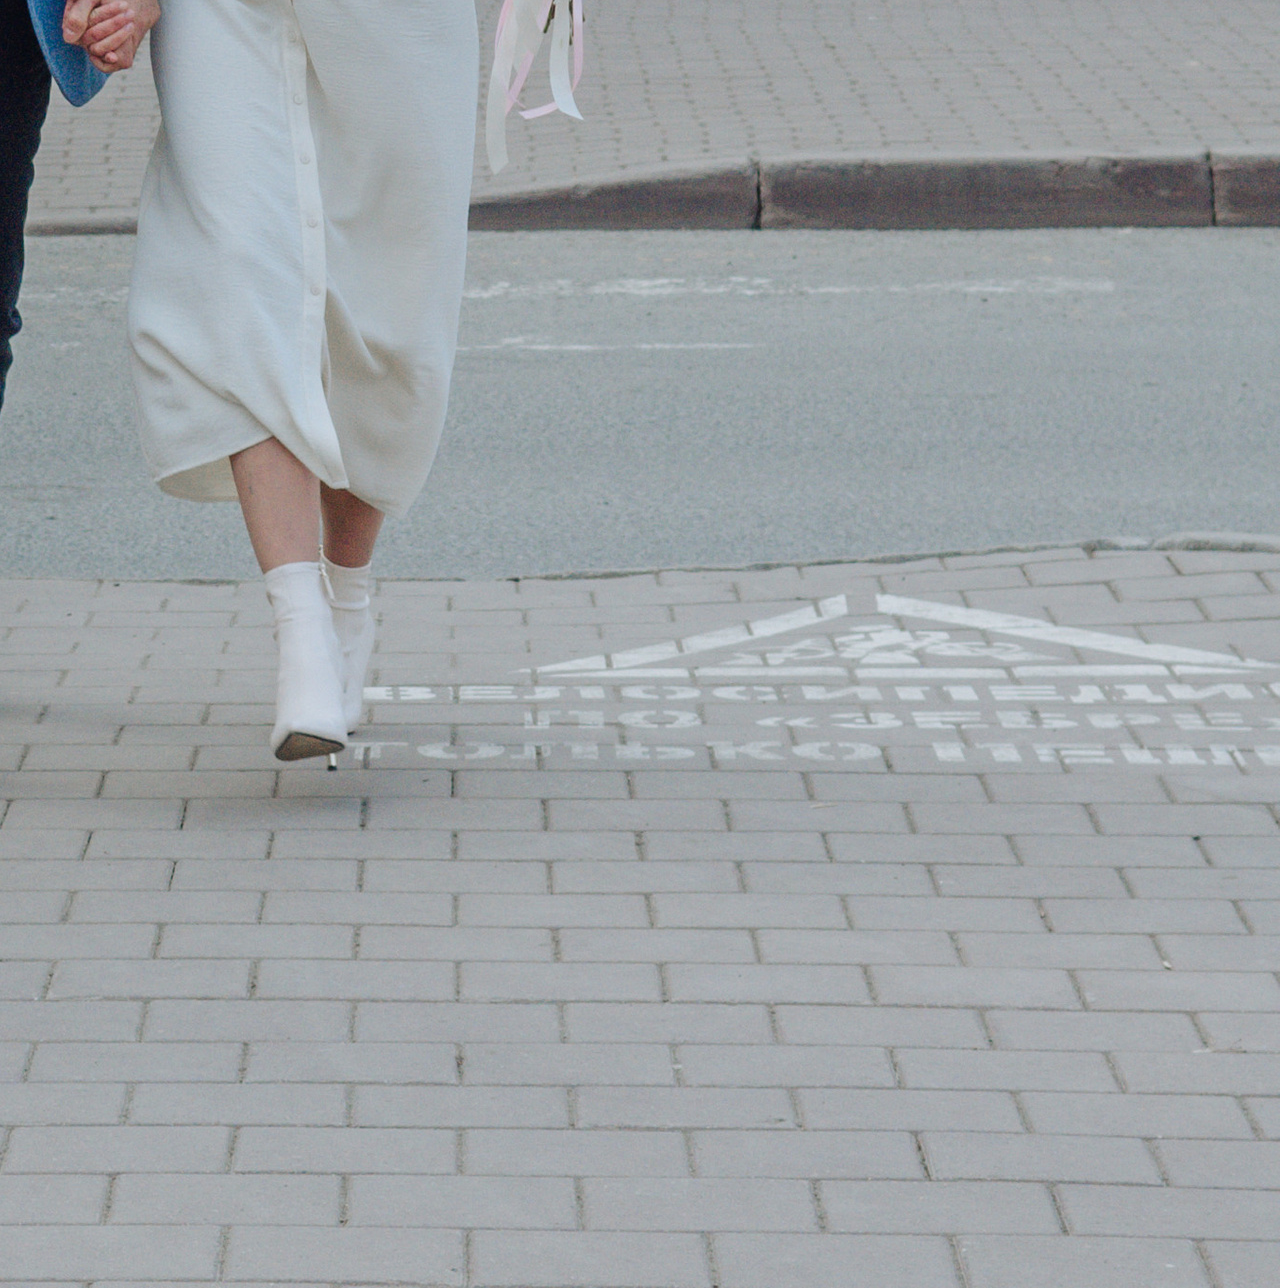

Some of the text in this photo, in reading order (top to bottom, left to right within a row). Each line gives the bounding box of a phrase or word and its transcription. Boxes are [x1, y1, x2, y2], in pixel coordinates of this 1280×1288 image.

[363, 683, 1280, 704] ВЕЛОСИПЕДИ
[524, 710, 705, 729] ПО
[347, 741, 1280, 766] ТОЛЬКО ПЕШ
